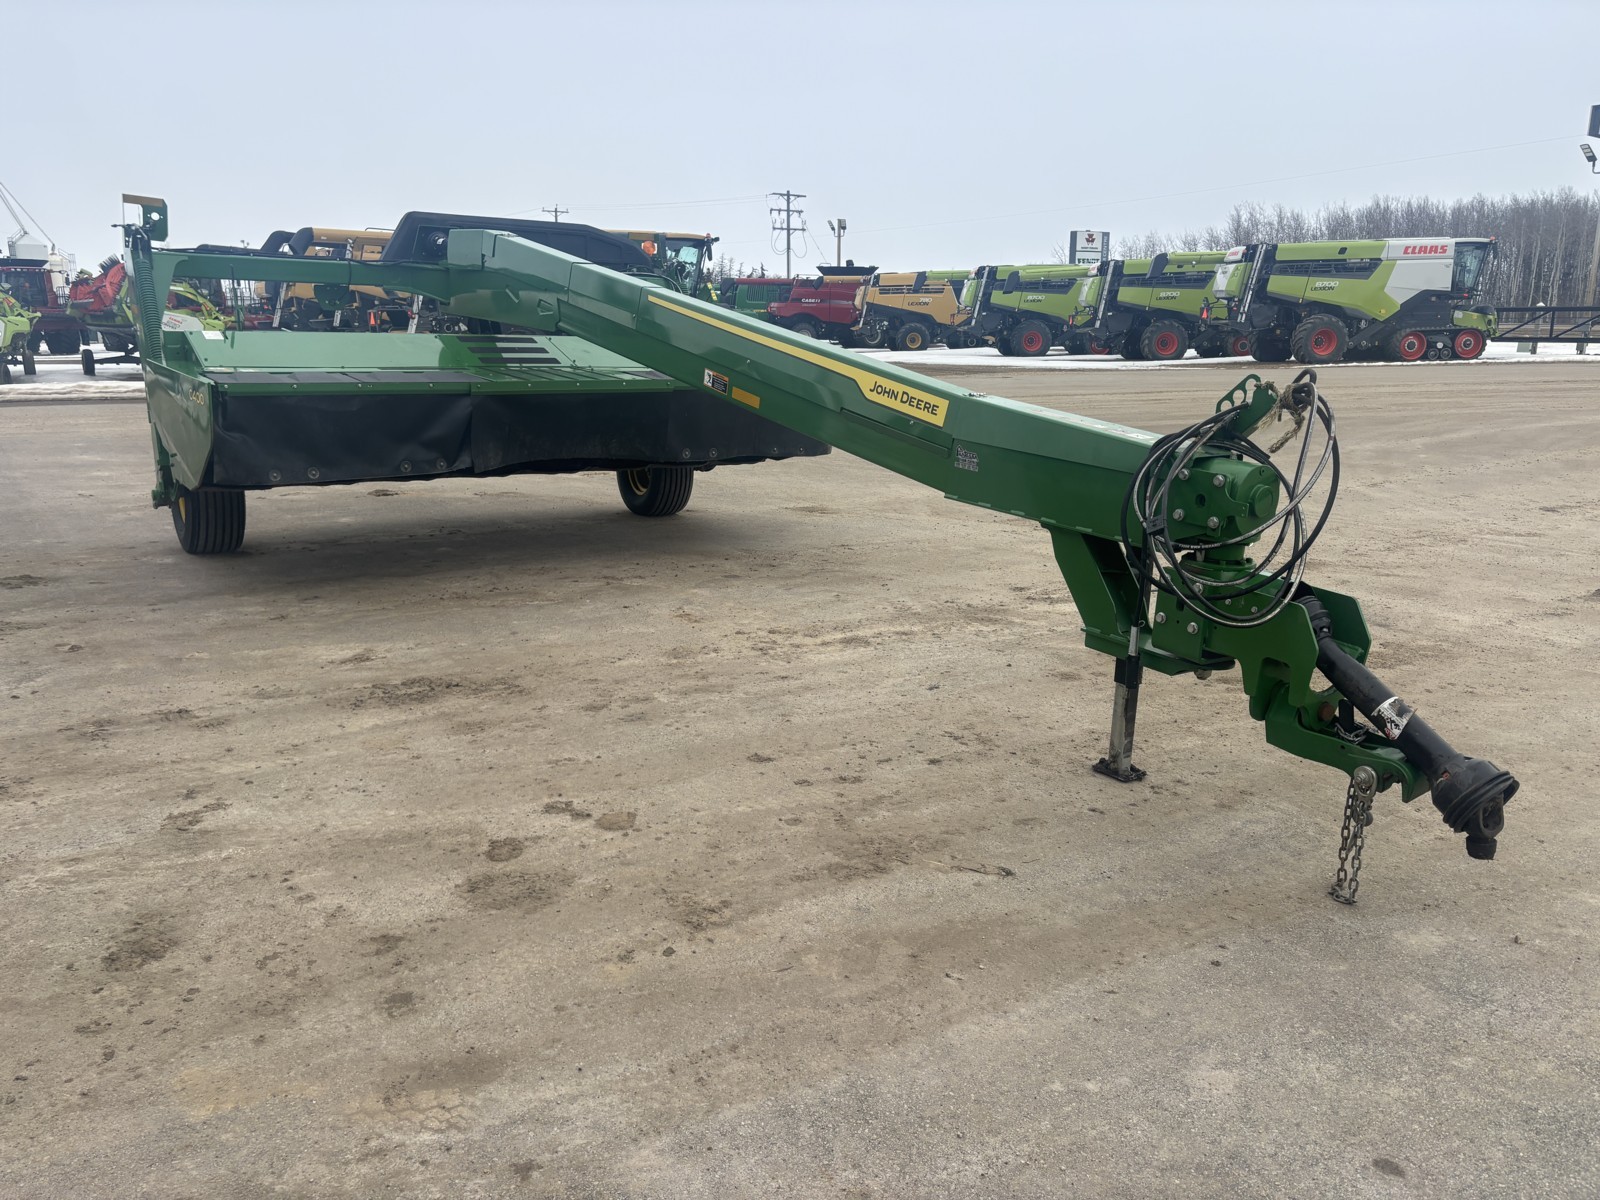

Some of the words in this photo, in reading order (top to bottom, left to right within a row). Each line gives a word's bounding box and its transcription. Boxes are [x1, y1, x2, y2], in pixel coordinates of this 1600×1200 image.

[1403, 245, 1448, 255] CLAAS
[869, 381, 900, 401] JOHN
[900, 390, 940, 416] DEERE
